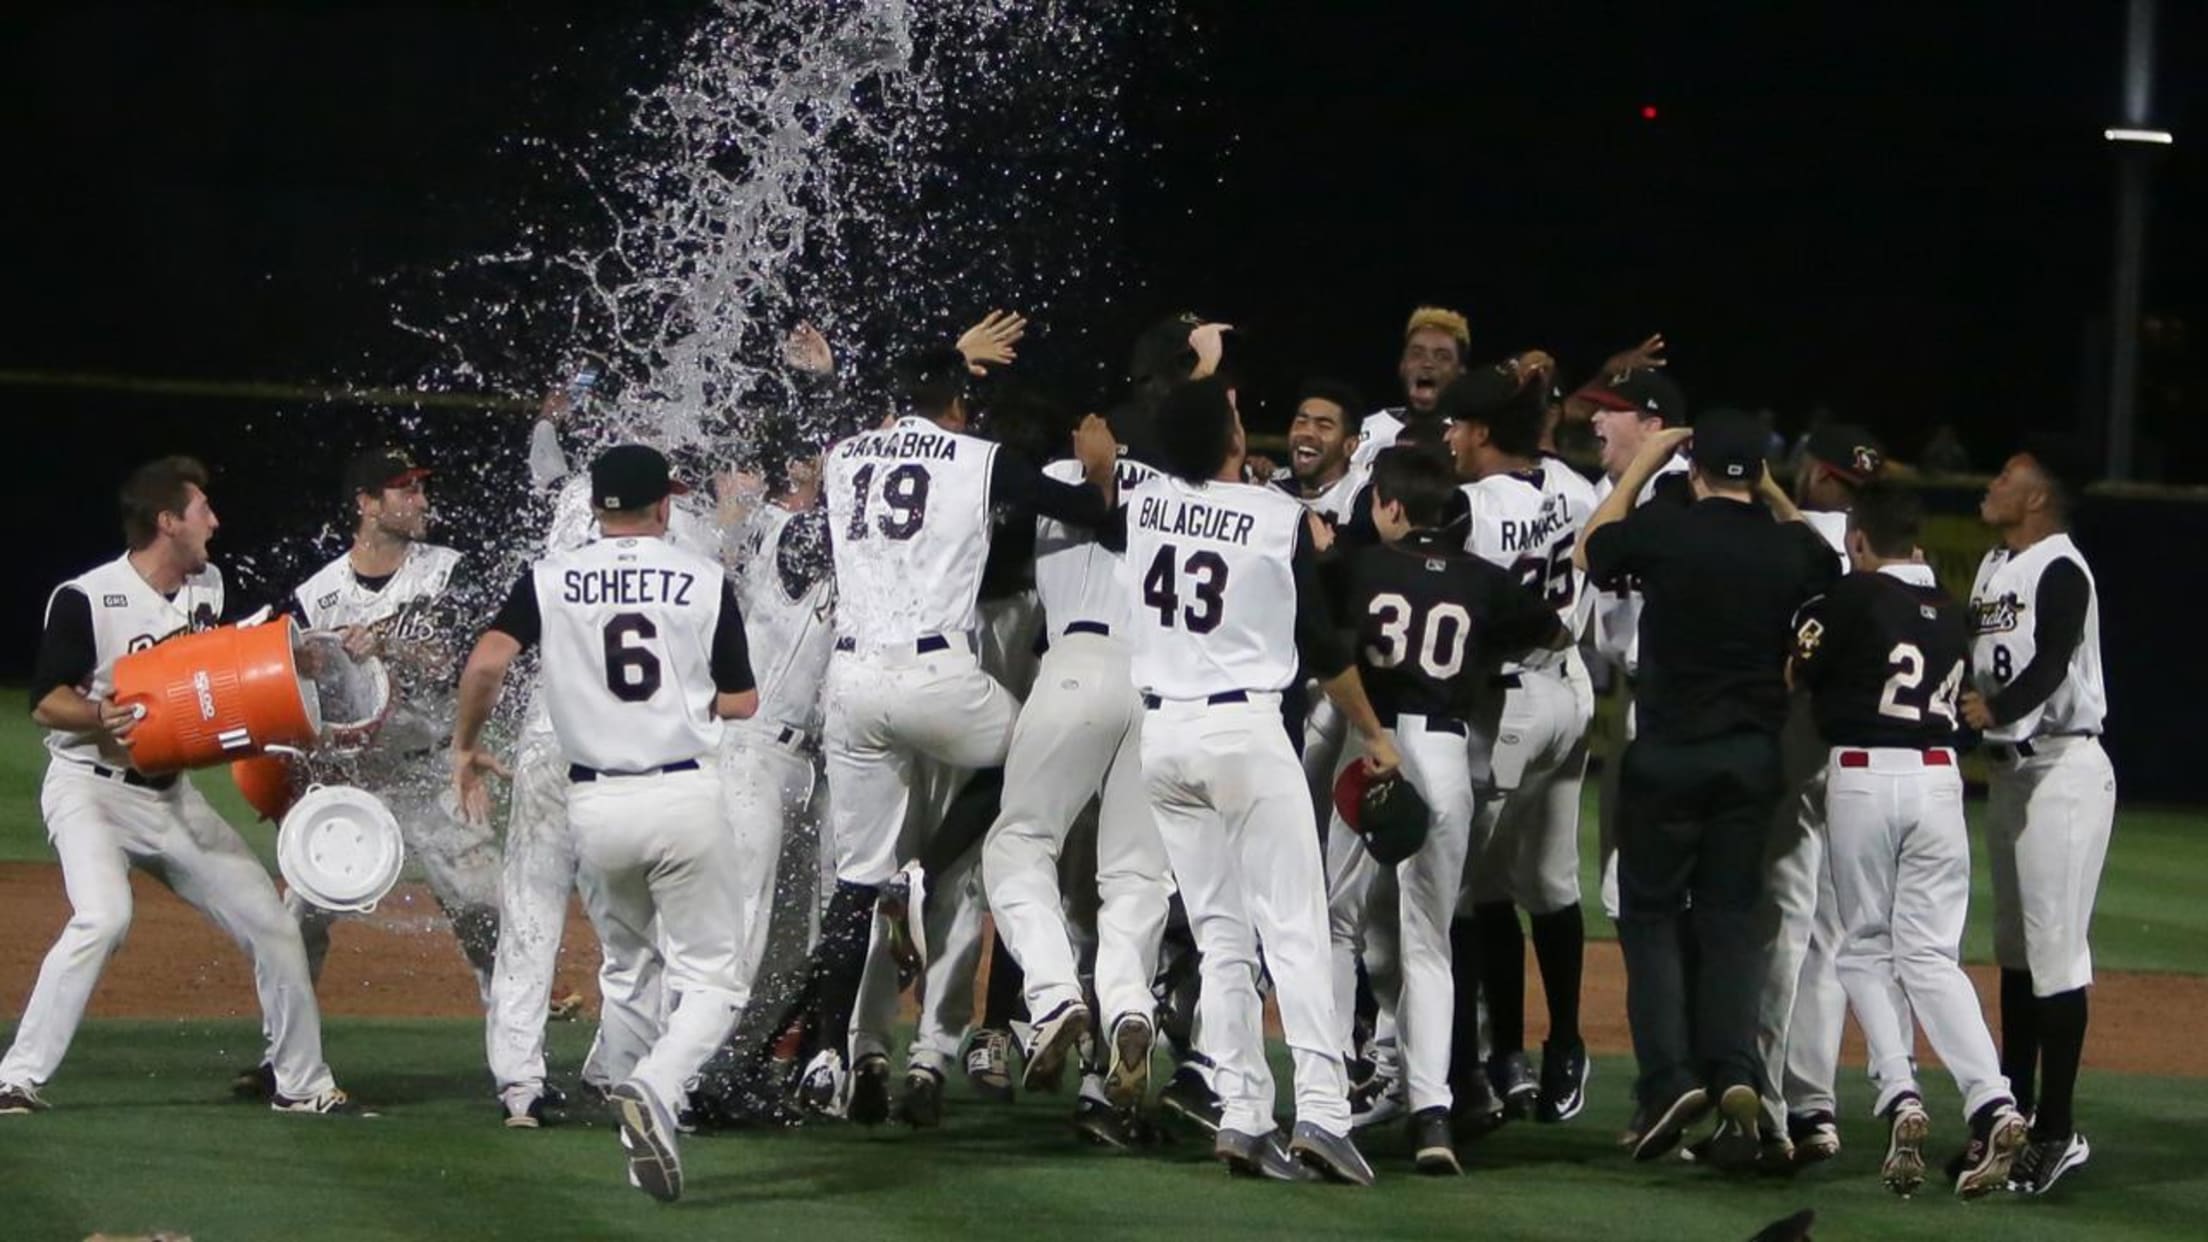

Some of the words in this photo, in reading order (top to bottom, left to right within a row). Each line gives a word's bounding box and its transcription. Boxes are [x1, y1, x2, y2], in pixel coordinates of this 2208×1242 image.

[845, 462, 932, 541] 19
[1139, 497, 1255, 545] BALAGUER
[564, 569, 695, 606] SCHEETZ
[1143, 543, 1229, 635] 43
[603, 612, 662, 702] 6
[1366, 593, 1471, 679] 30
[1993, 644, 2012, 683] 8
[1878, 642, 1965, 731] 24
